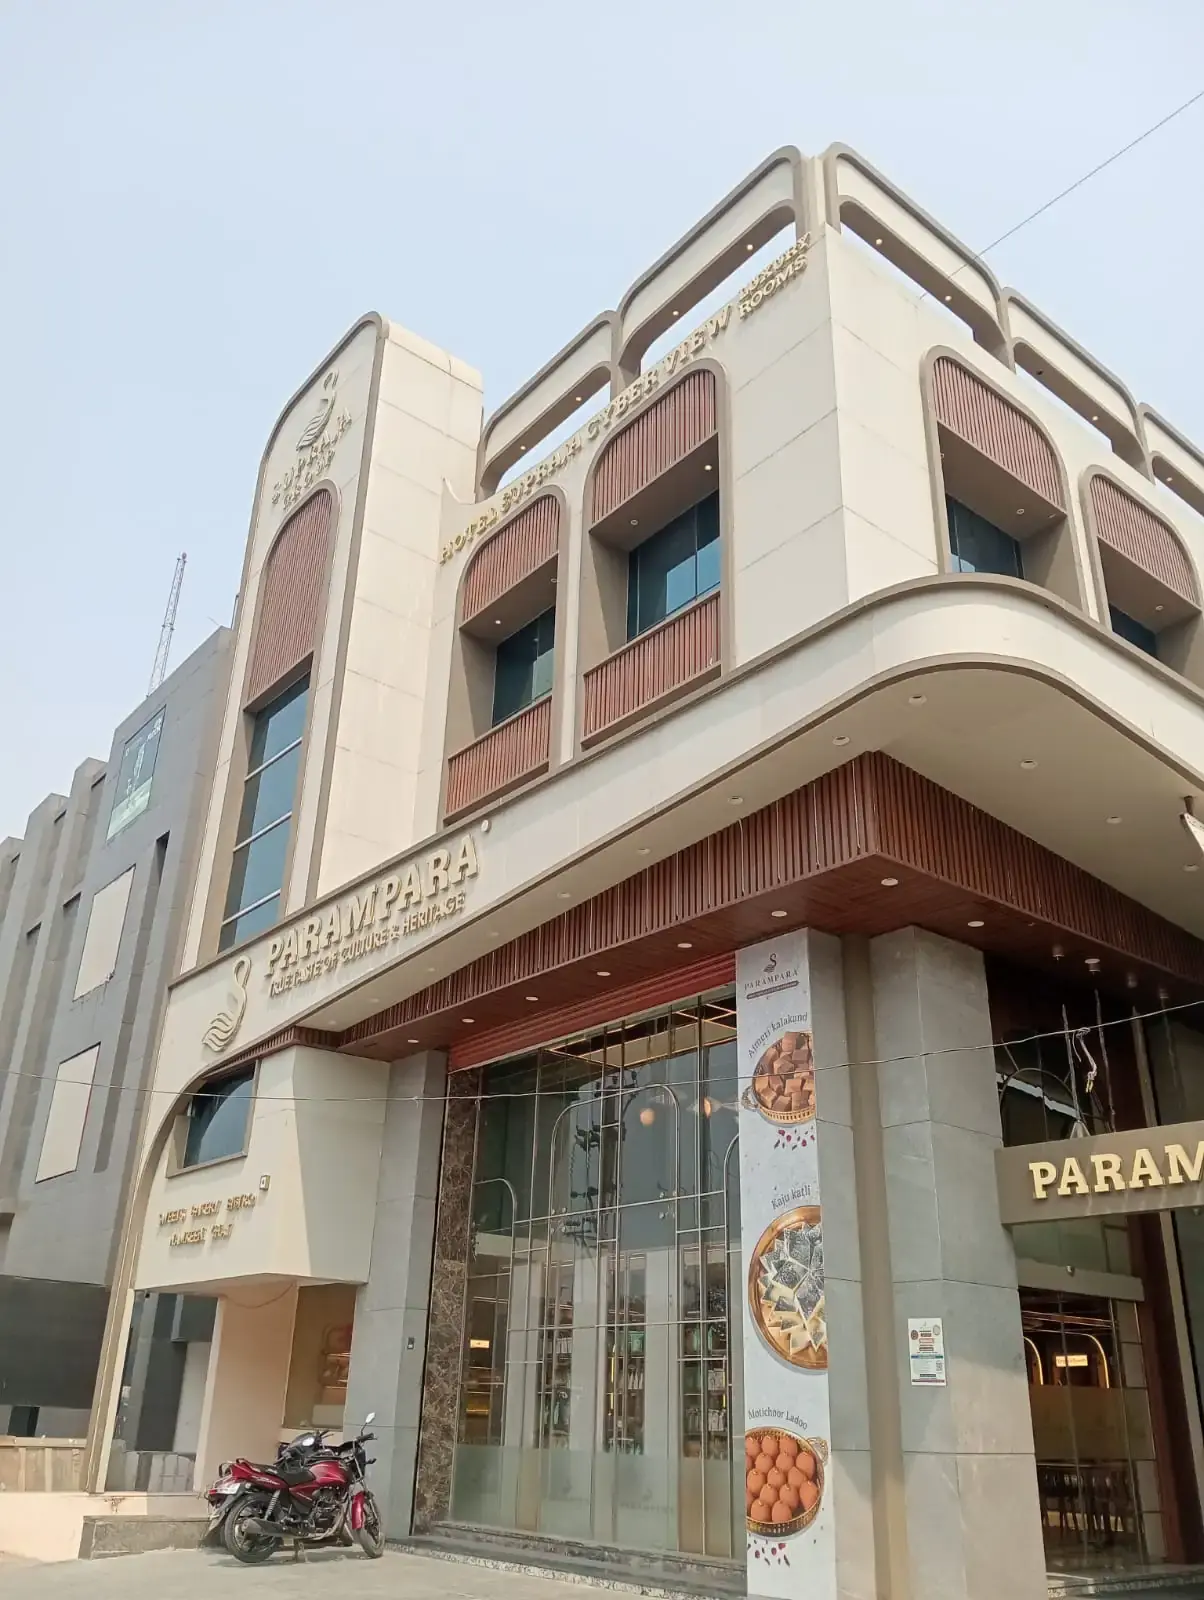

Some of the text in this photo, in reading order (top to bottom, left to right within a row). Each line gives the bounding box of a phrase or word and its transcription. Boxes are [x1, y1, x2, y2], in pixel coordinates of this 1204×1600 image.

[738, 231, 811, 301] LUXURY
[738, 254, 808, 319] ROOMS
[439, 507, 499, 565] HOTEL
[587, 368, 660, 441] CYBER
[662, 303, 732, 374] VIEW
[264, 832, 480, 978] PARAMPARA
[323, 951, 339, 972] OF
[341, 926, 388, 963] CULTURE
[403, 890, 466, 937] HERITAGE
[744, 967, 799, 991] PARAMPARA
[771, 1011, 808, 1033] kalakund
[771, 1184, 811, 1210] Kaju katli
[786, 1410, 808, 1430] Ladoo
